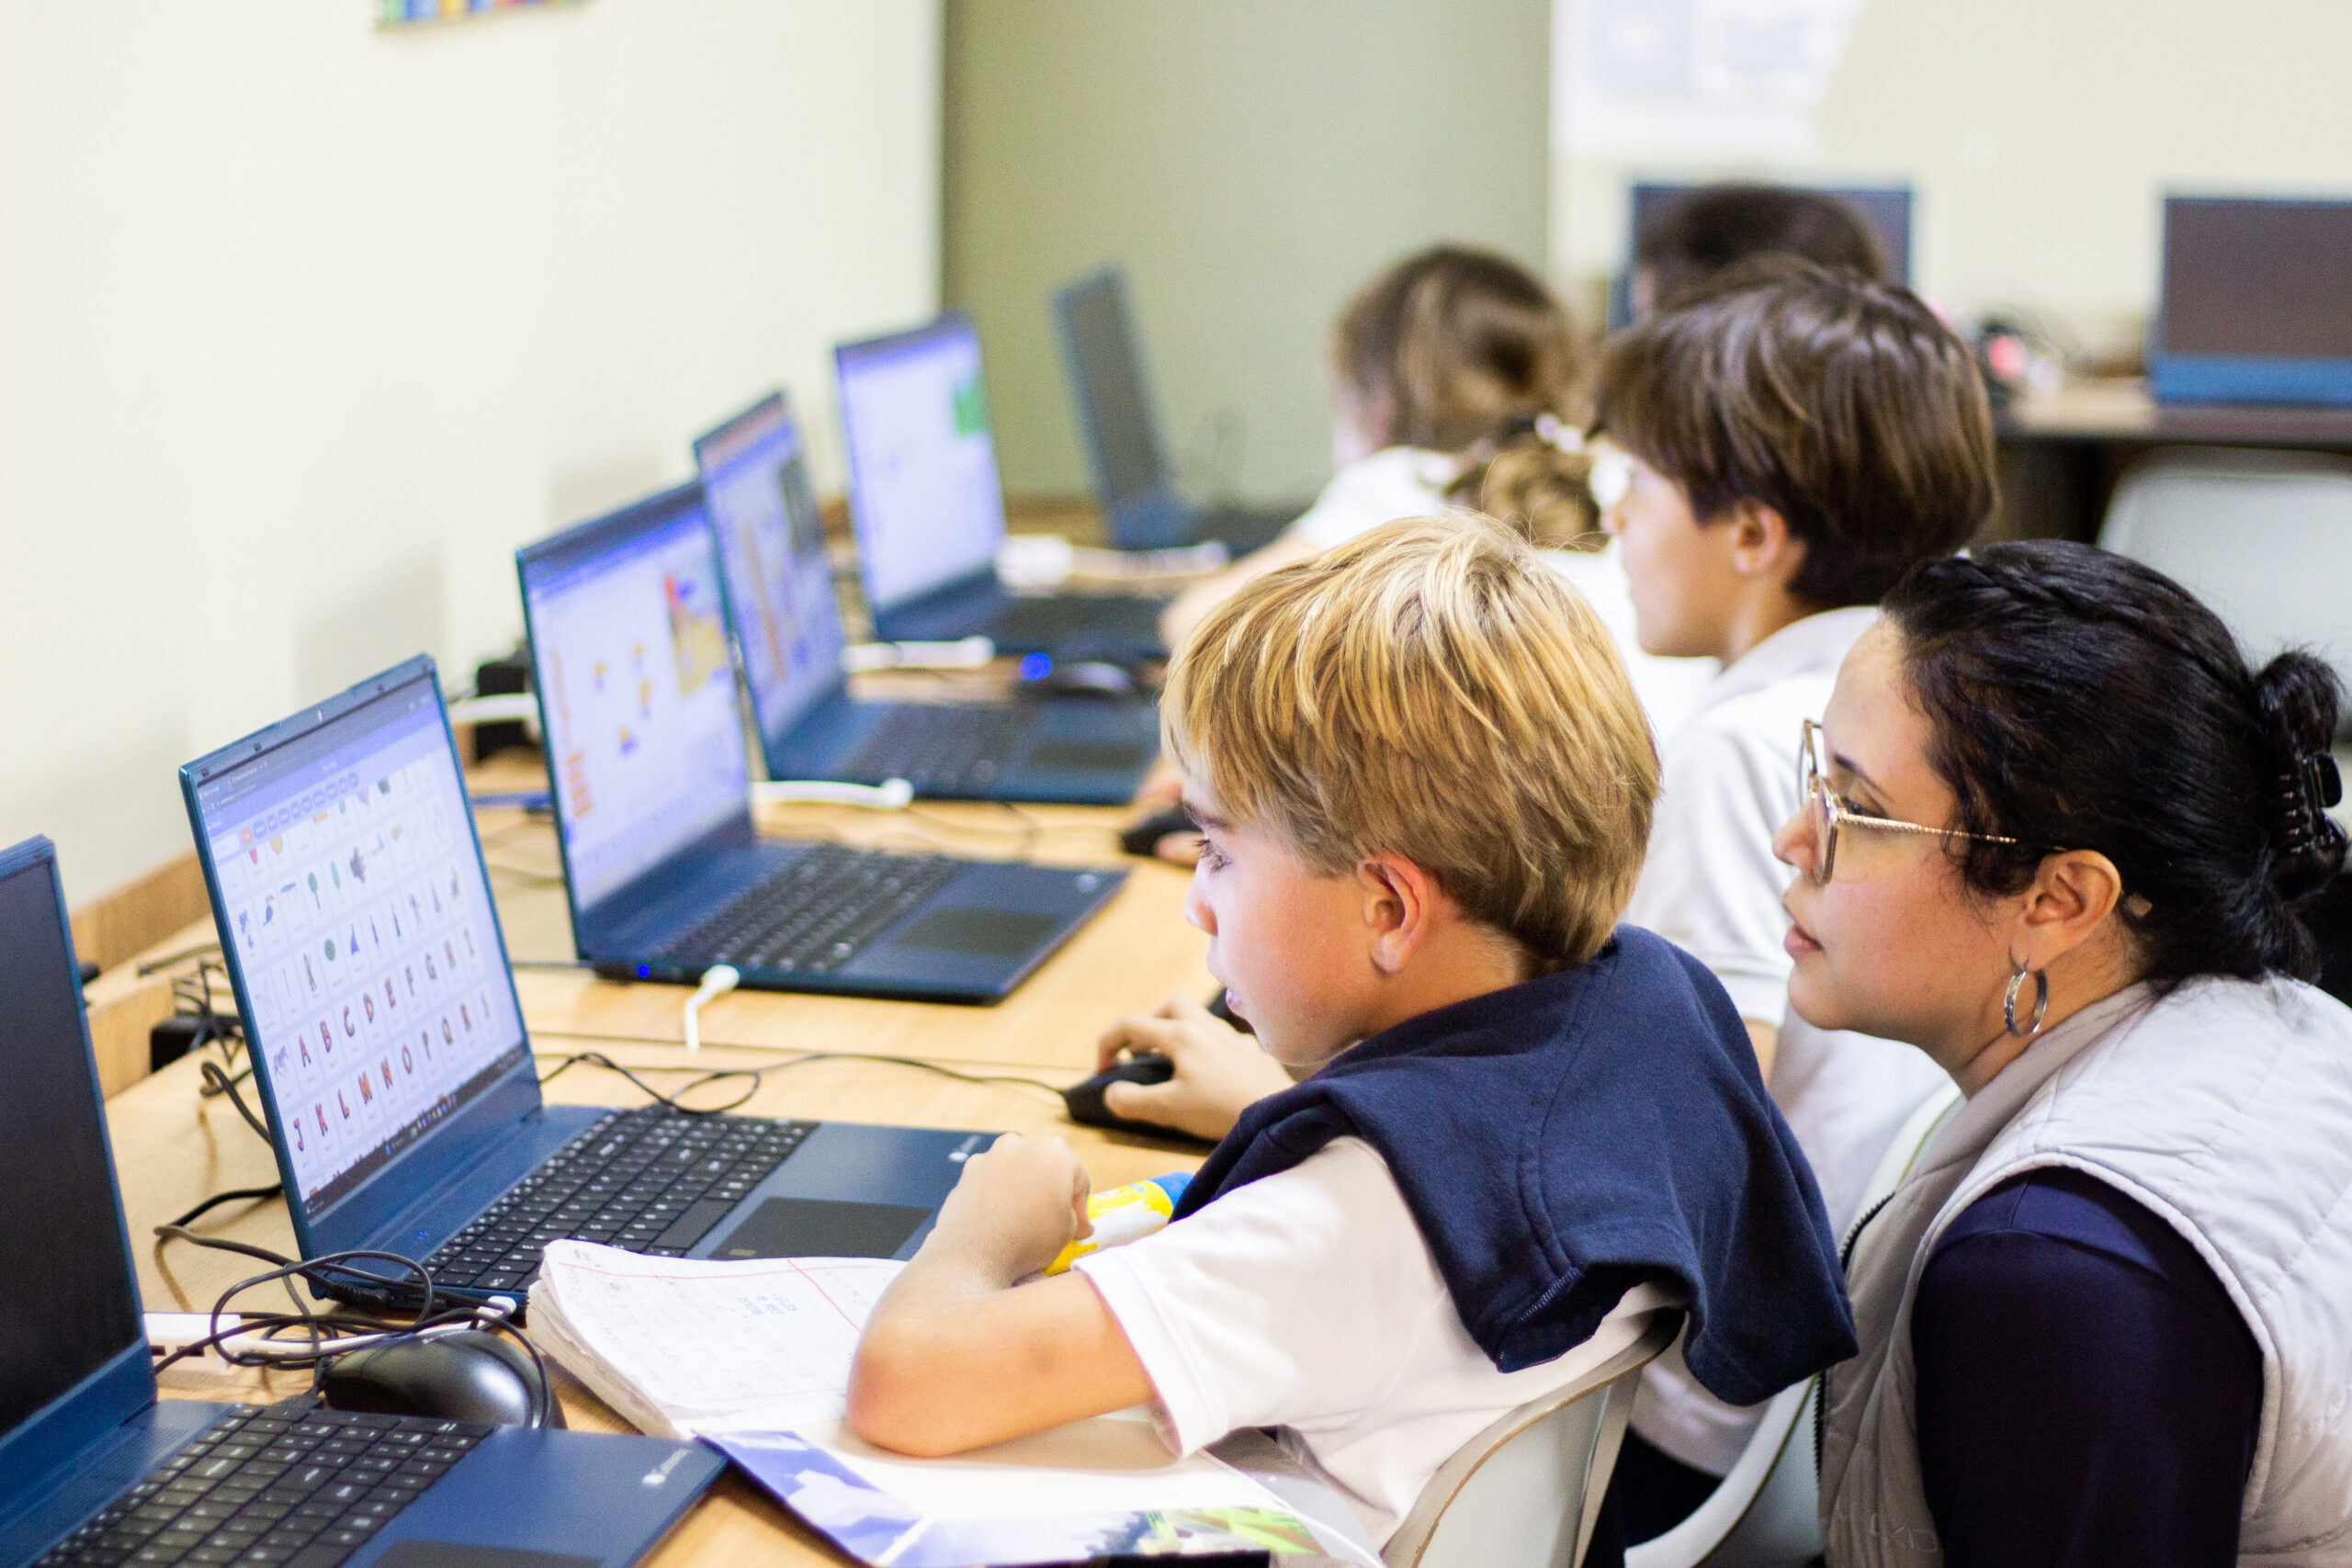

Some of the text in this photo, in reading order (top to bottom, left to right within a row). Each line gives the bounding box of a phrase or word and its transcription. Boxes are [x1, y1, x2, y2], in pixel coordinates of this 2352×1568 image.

[300, 1035, 311, 1067] A
[320, 1020, 332, 1053] B
[344, 1005, 356, 1037] C
[363, 993, 374, 1024] D
[294, 1118, 304, 1152] J
[315, 1103, 328, 1136] K
[338, 1089, 350, 1120] L
[358, 1071, 373, 1105] M
[381, 1056, 393, 1089] N
[401, 1043, 413, 1074] O
